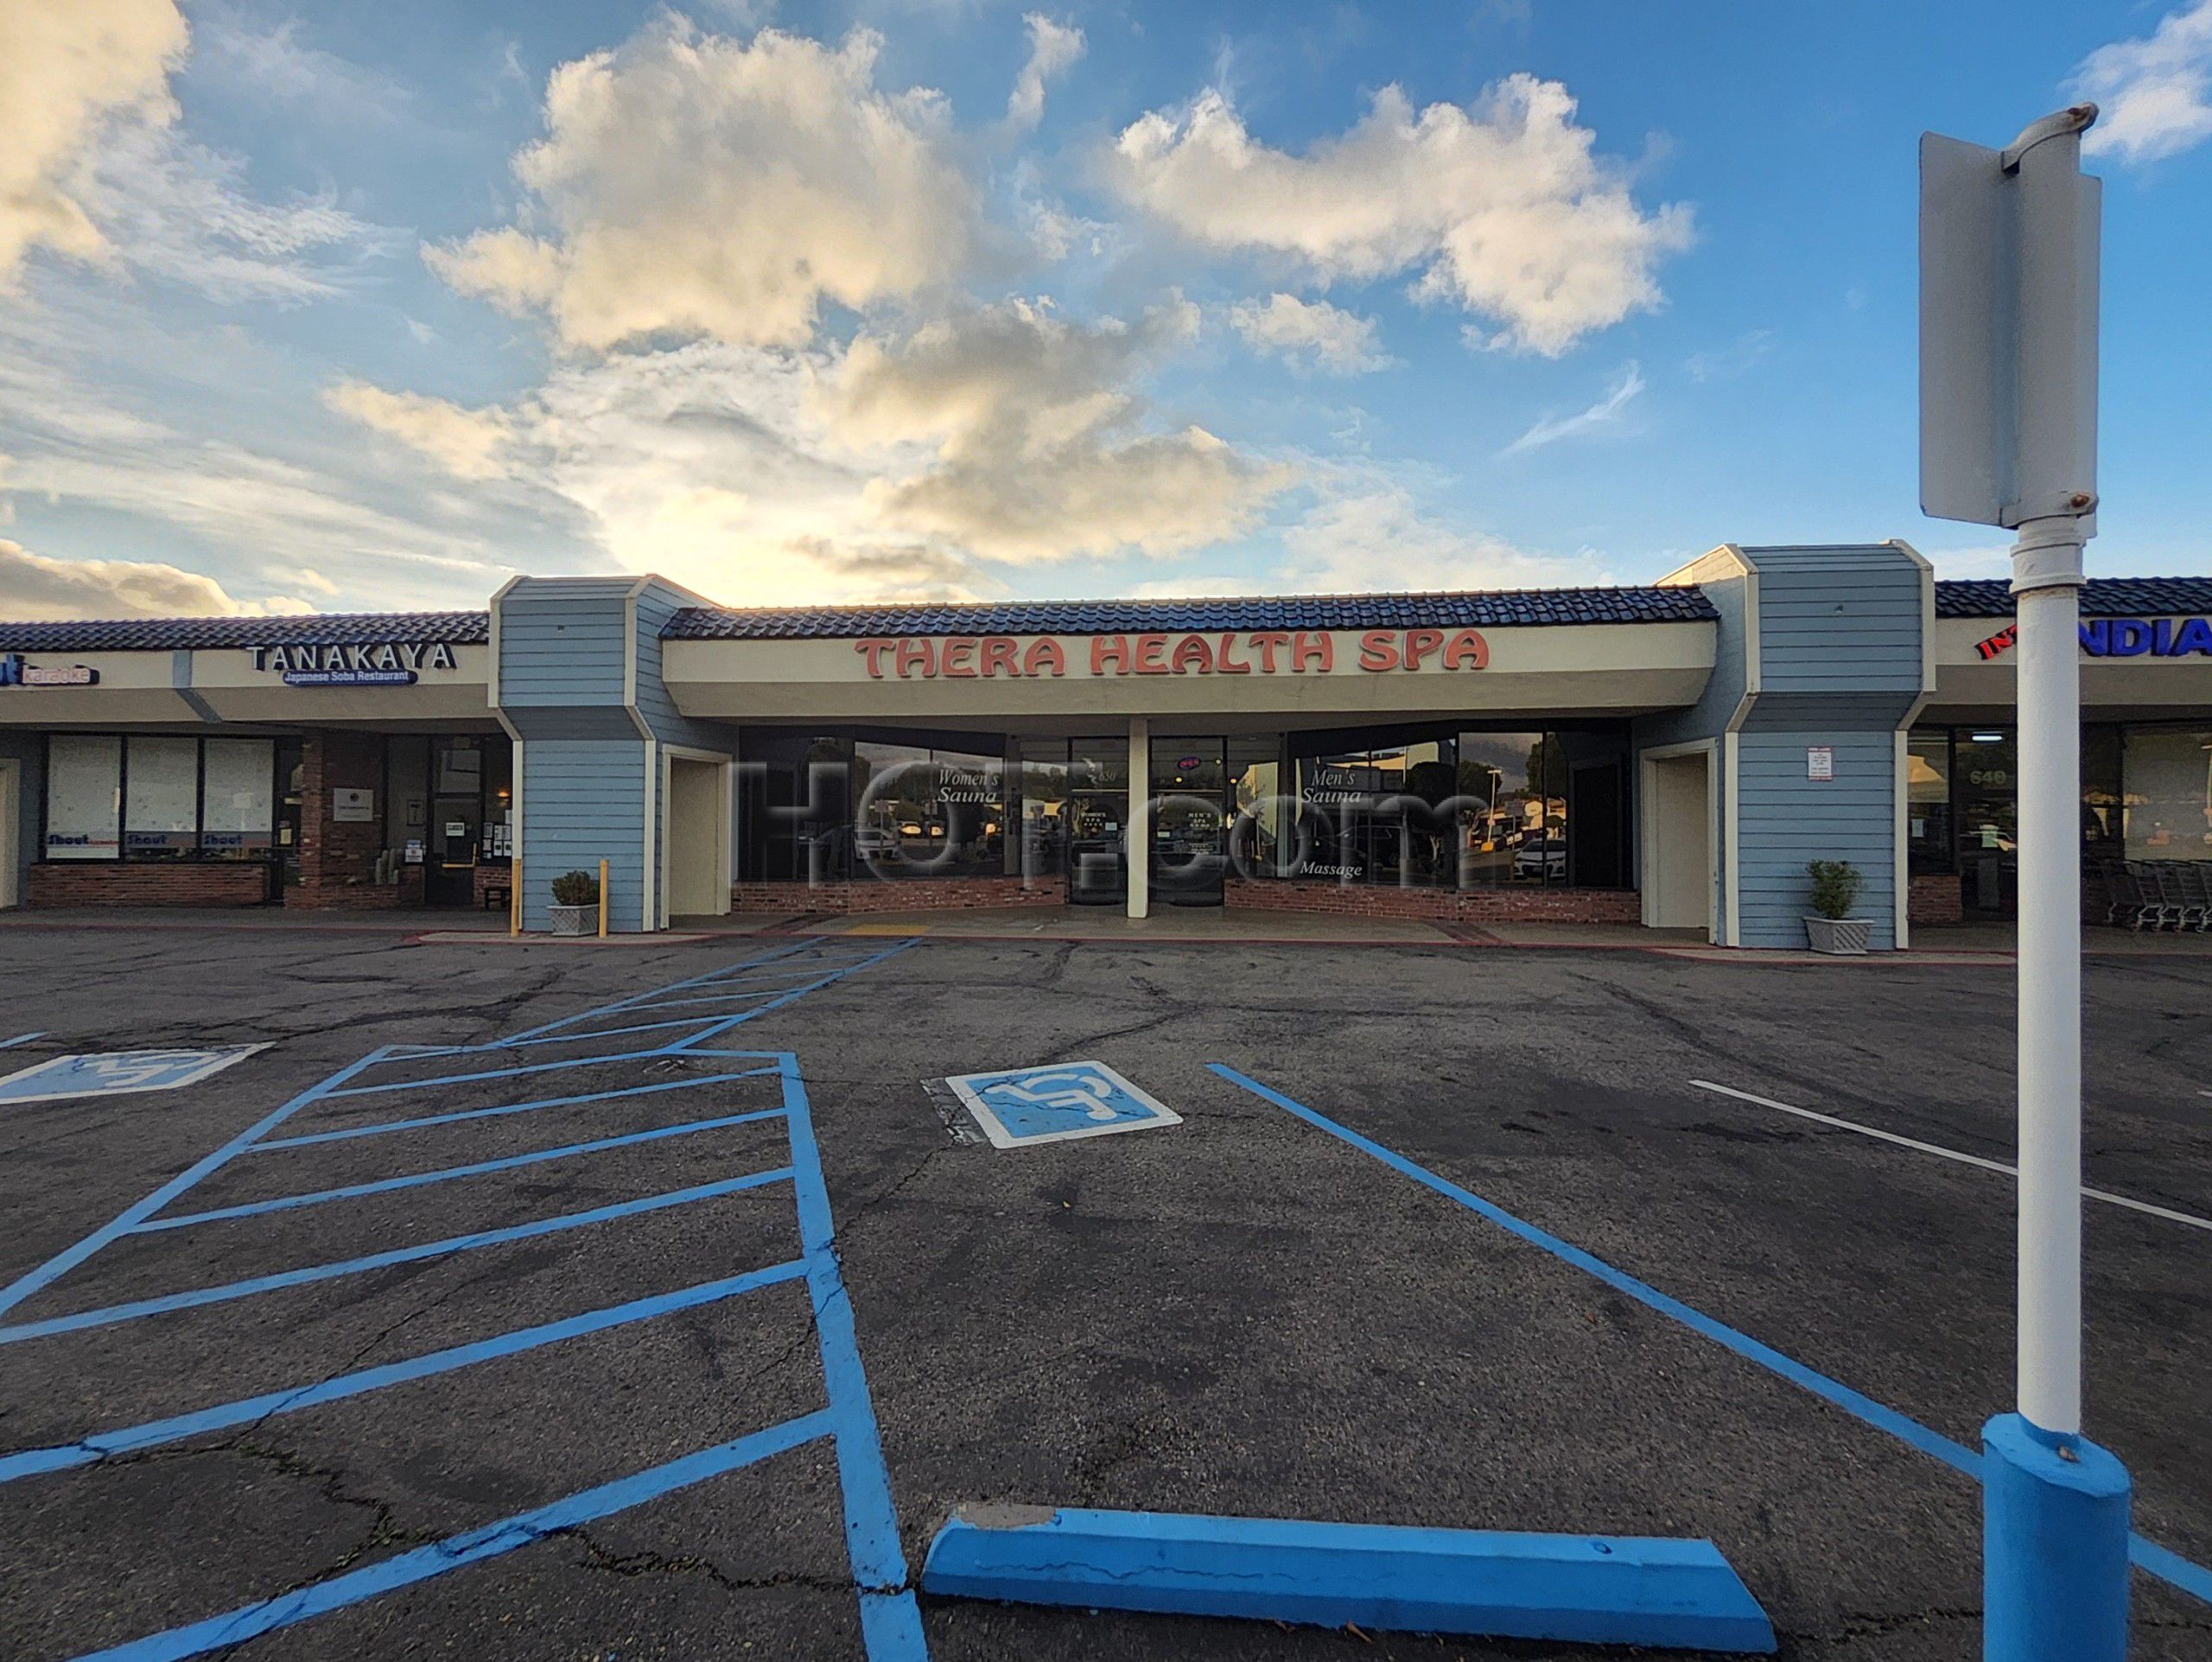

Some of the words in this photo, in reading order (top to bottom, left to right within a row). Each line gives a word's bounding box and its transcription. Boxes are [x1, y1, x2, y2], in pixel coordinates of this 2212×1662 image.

[2077, 619, 2212, 657] NDIA
[246, 643, 455, 671] TANAKAYA
[855, 636, 1065, 678] THERA
[1090, 631, 1335, 675] HEALTH
[1358, 628, 1490, 671] SPA
[285, 671, 329, 683] Japanese
[331, 671, 355, 681] Soba
[357, 670, 409, 681] Restaurant
[939, 769, 1000, 786] Women's
[1311, 769, 1356, 786] Men's
[938, 786, 998, 803] Sauna
[1301, 787, 1362, 804] Sauna
[1300, 861, 1363, 879] Massage
